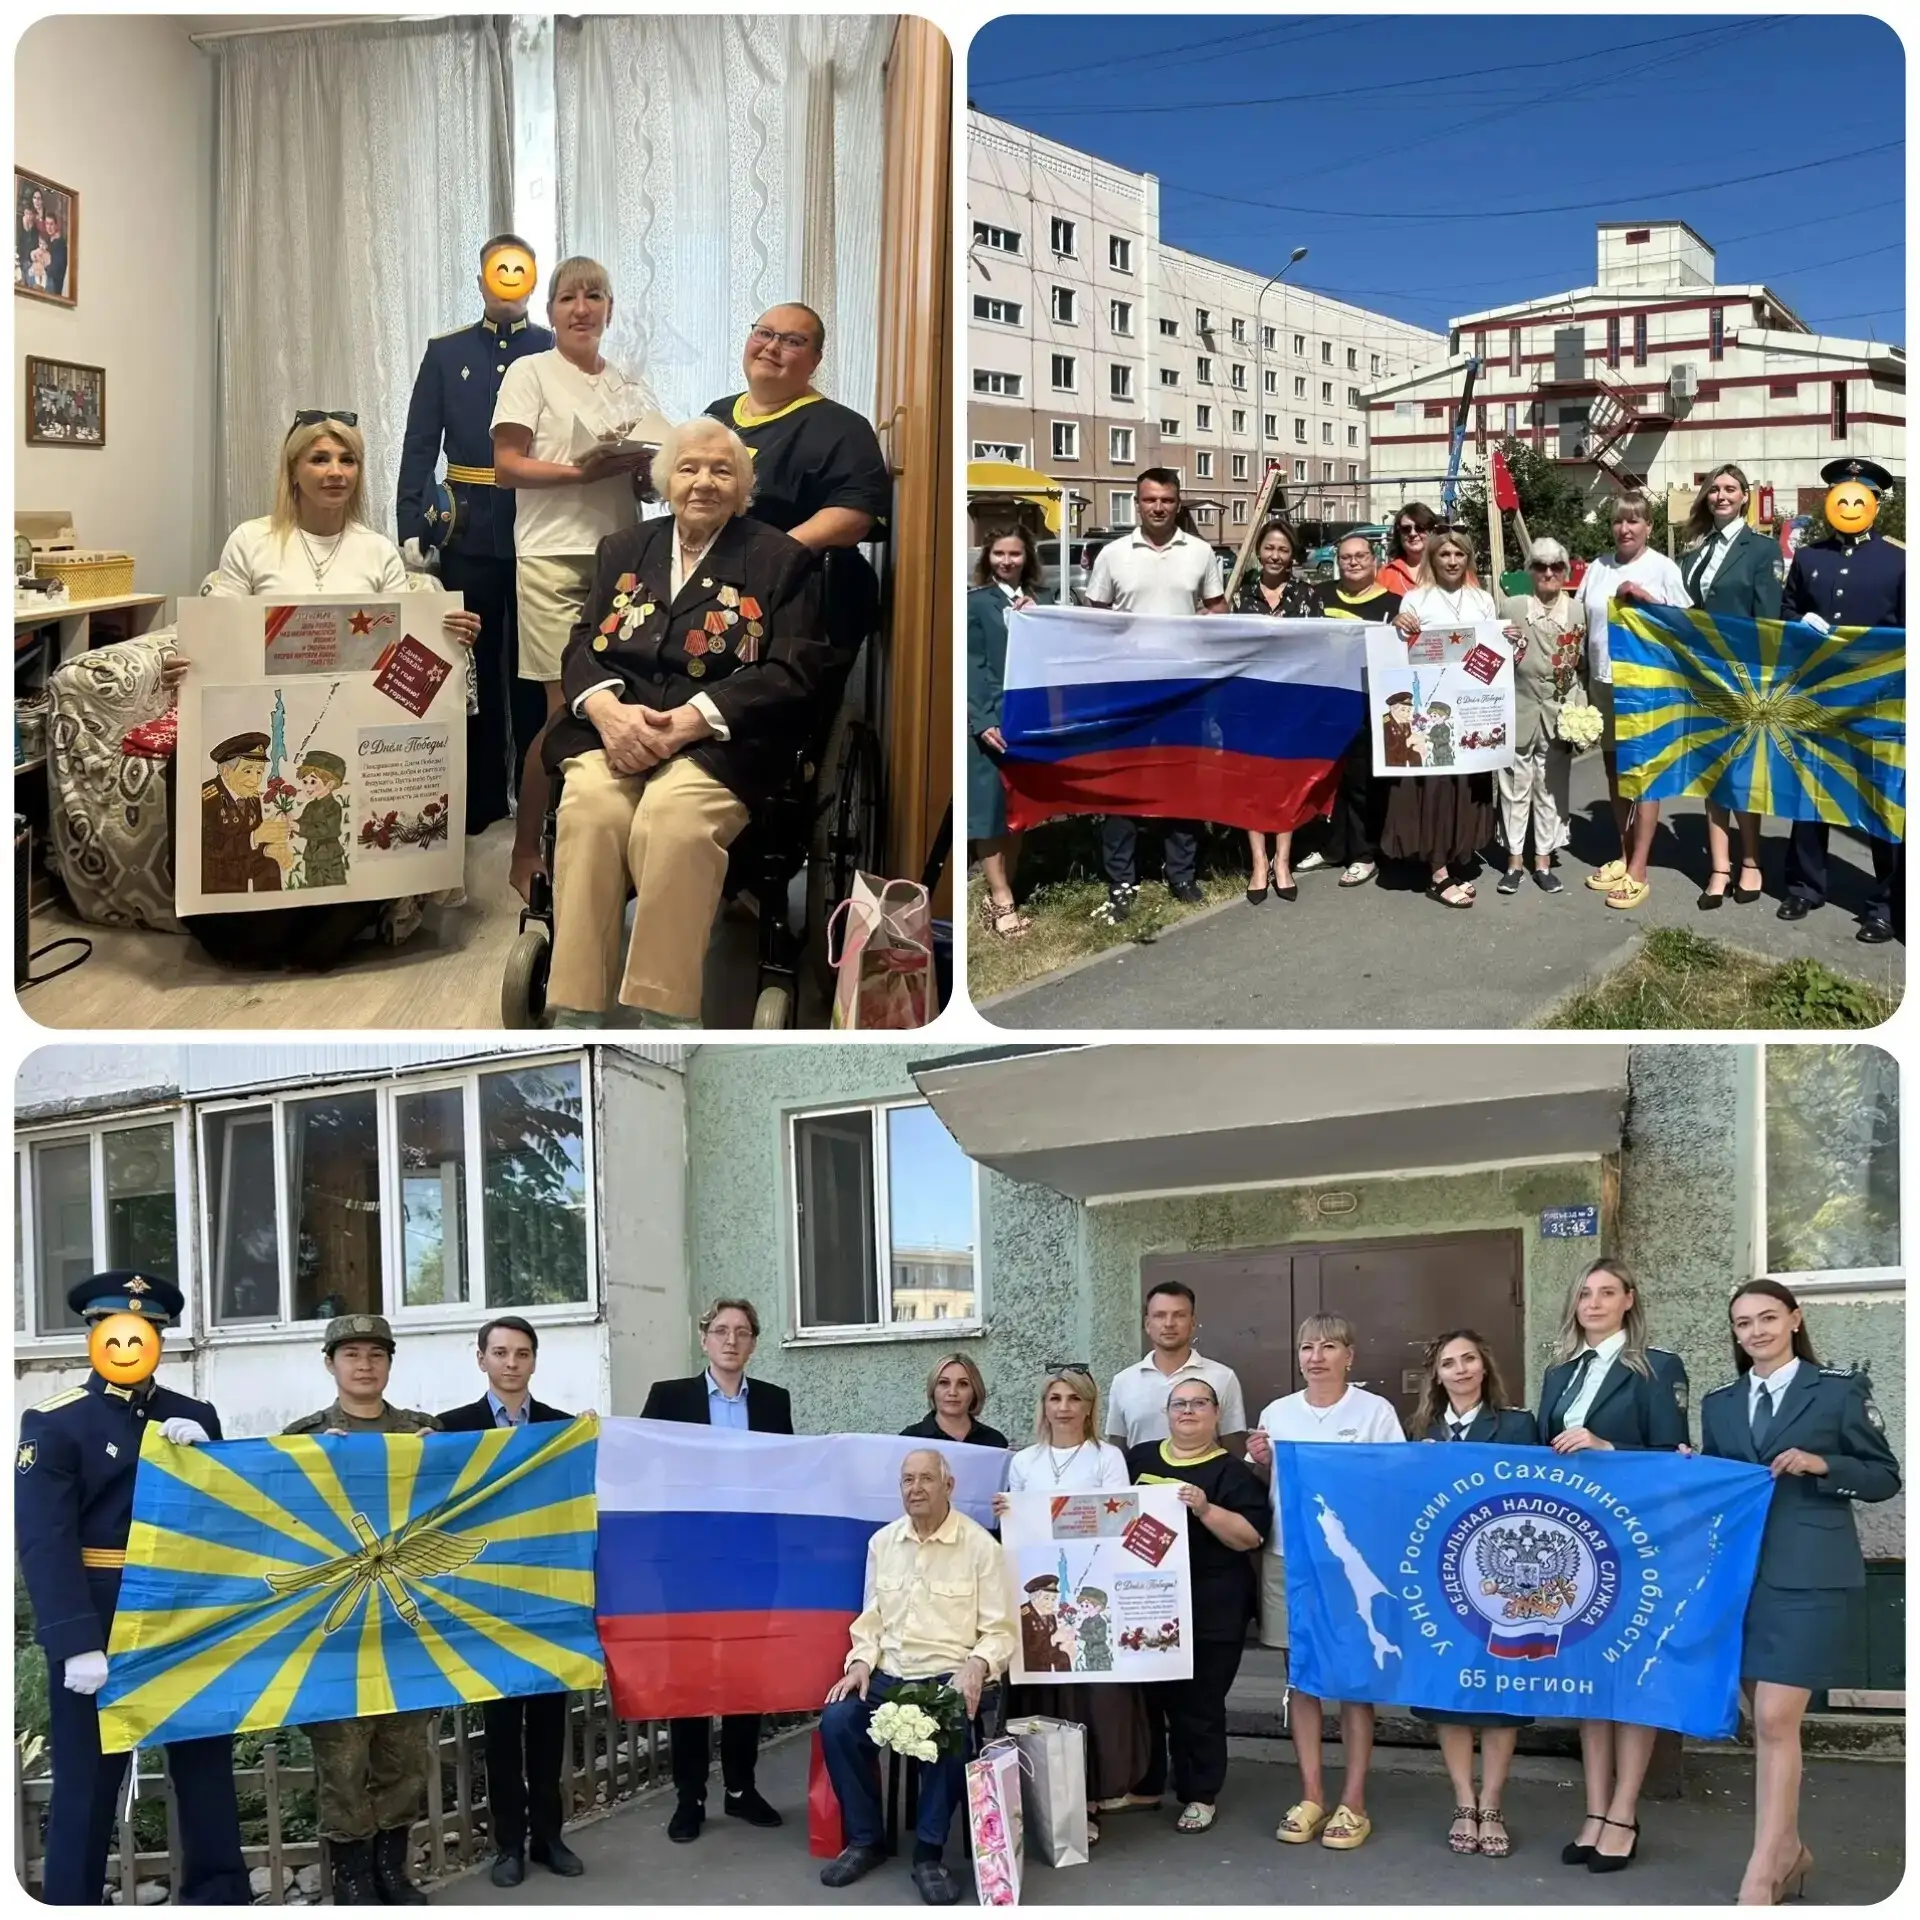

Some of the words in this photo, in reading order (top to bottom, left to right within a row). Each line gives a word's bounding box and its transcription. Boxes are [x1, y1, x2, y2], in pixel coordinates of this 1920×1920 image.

[389, 688, 421, 712] горжусь!
[393, 678, 421, 699] помню!
[357, 740, 370, 756] С
[370, 739, 403, 755] Днём
[404, 736, 449, 756] Победы!
[1453, 1471, 1486, 1495] по
[1400, 1491, 1451, 1575] России
[1494, 1460, 1660, 1559] Сахалинской
[1442, 1505, 1493, 1616] ФЕДЕРАЛЬНАЯ
[1502, 1497, 1608, 1551] НАЛОГОВАЯ
[1581, 1560, 1615, 1626] СЛУЖБА
[1402, 1585, 1454, 1656] УФНС
[1602, 1568, 1664, 1664] области
[1459, 1668, 1487, 1689] 65
[1496, 1672, 1594, 1694] регион
